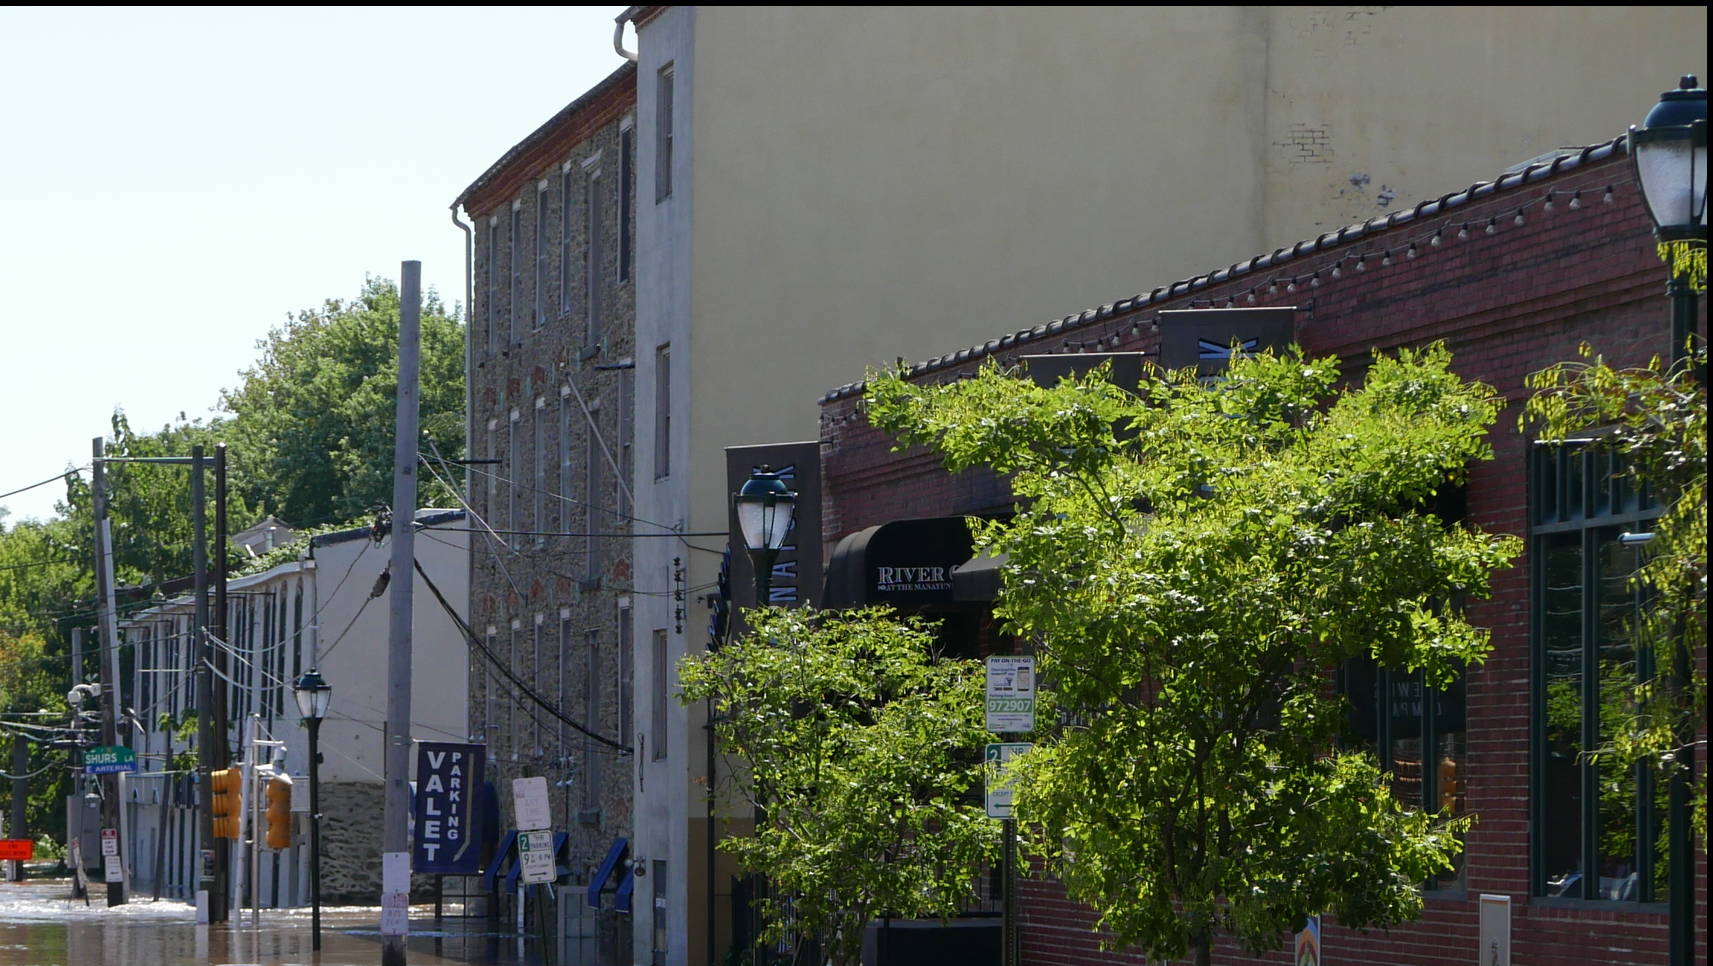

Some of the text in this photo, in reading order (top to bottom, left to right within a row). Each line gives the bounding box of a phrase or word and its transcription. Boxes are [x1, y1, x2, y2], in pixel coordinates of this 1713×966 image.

[877, 566, 945, 585] RIVER
[914, 583, 954, 591] MANAYUN
[989, 700, 1031, 712] 972907
[85, 753, 135, 765] SHURS LA
[447, 752, 462, 840] PARKING
[423, 751, 446, 862] VALET
[521, 837, 528, 850] 2
[523, 853, 529, 865] 9
